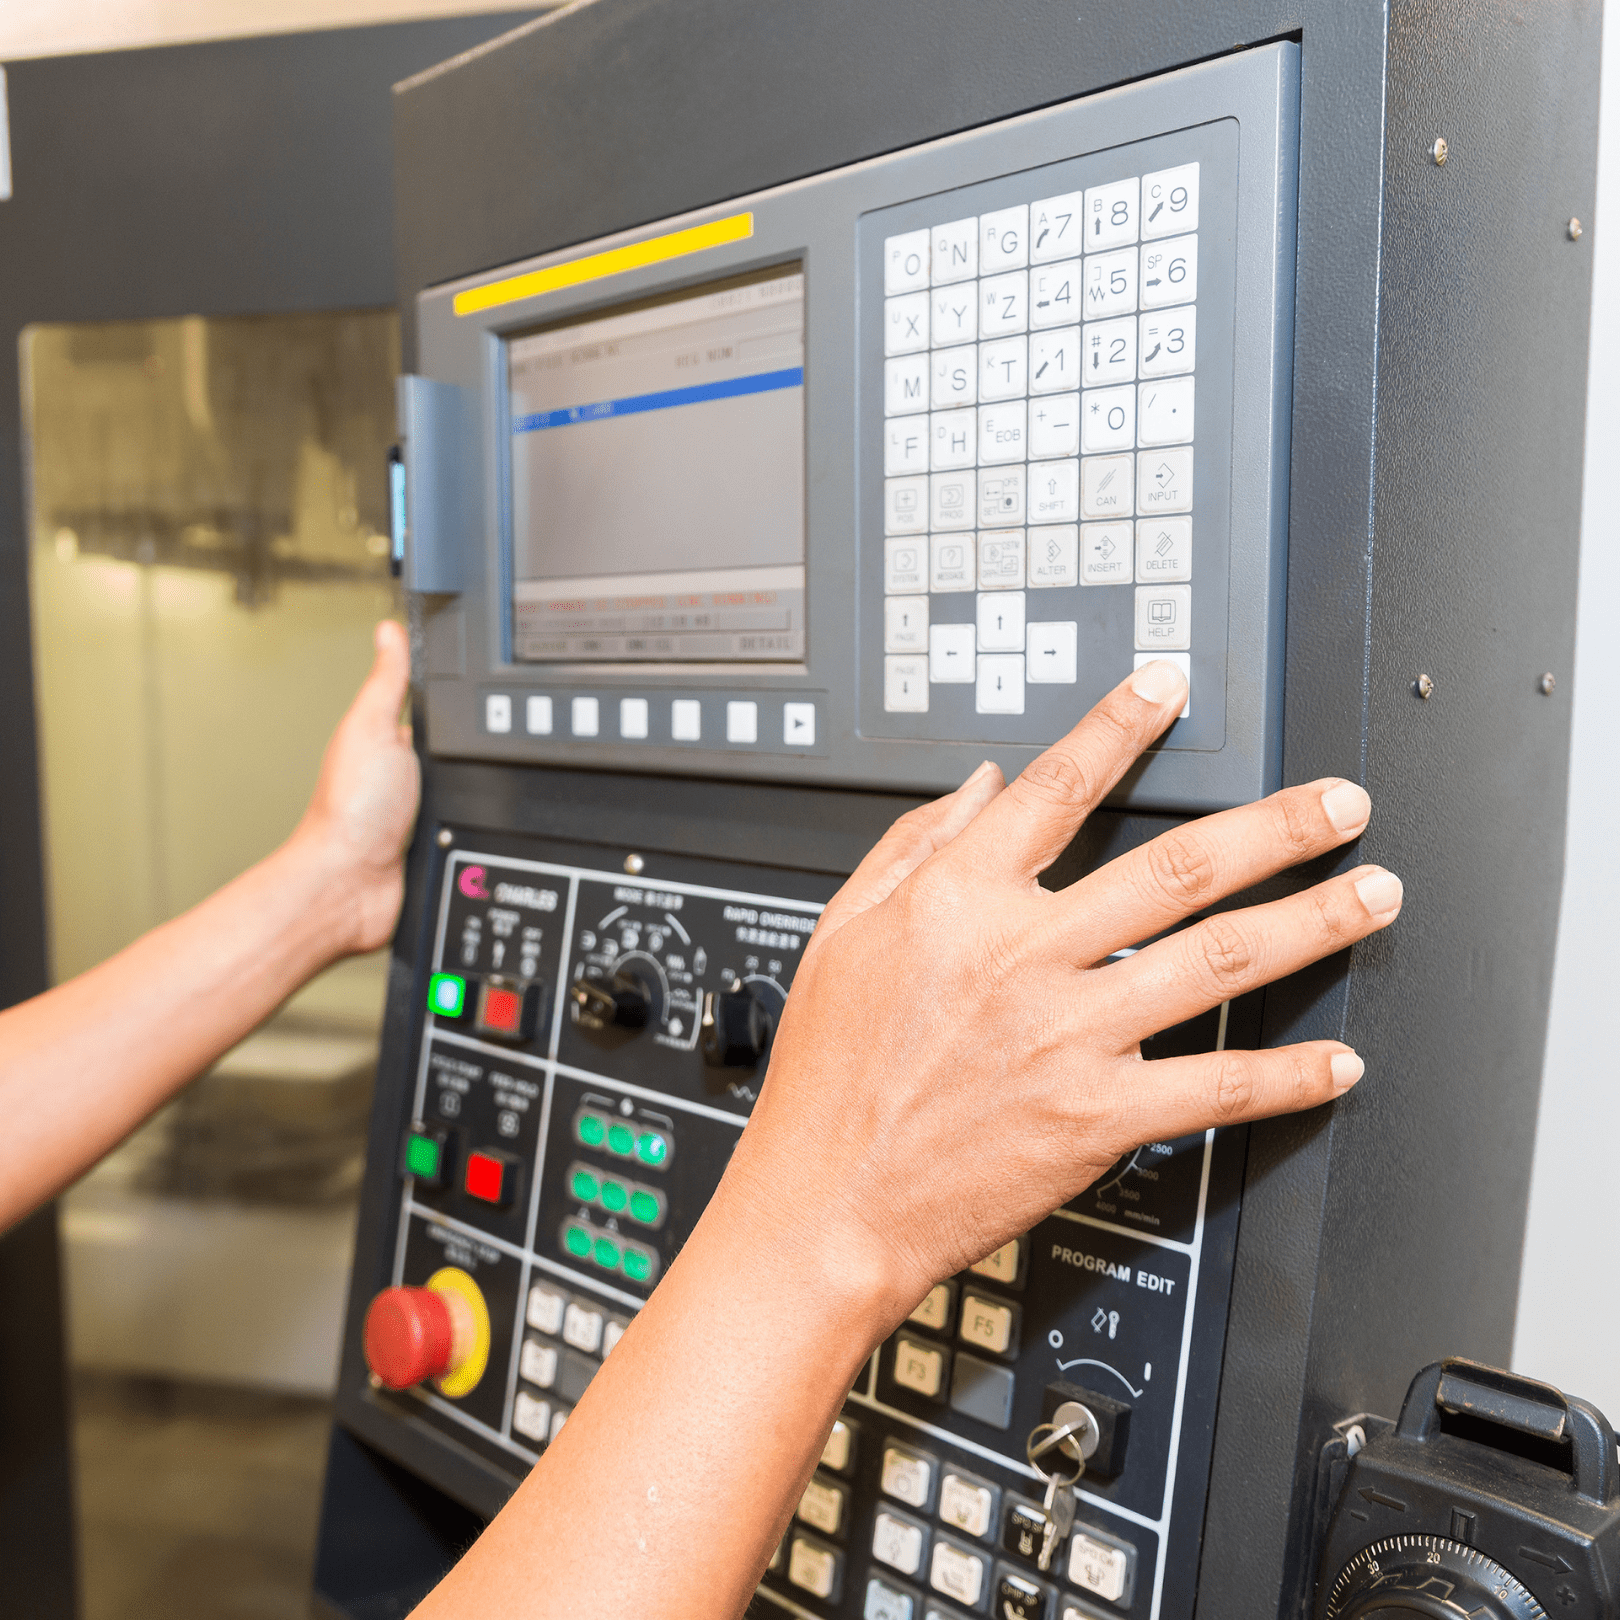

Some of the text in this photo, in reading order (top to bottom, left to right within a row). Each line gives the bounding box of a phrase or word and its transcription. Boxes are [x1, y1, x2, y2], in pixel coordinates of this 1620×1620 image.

[1151, 184, 1162, 199] C
[1170, 186, 1188, 213] 9
[1093, 199, 1103, 213] B
[1110, 200, 1129, 226] 8
[1038, 212, 1048, 226] A
[1055, 213, 1072, 239] 7
[952, 241, 967, 266] N
[1001, 231, 1018, 254] G
[1147, 254, 1163, 270] SP
[1168, 257, 1186, 284] 6
[1054, 280, 1071, 304] 4
[1110, 268, 1127, 295] 5
[952, 305, 968, 328] Y
[1002, 295, 1016, 320] Z
[905, 314, 920, 339] X
[1109, 338, 1126, 363] 2
[1166, 328, 1185, 354] 3
[1000, 359, 1017, 383] T
[1055, 348, 1064, 371] 1
[904, 376, 920, 399] M
[951, 368, 967, 391] S
[951, 431, 966, 453] H
[996, 428, 1021, 443] EOB
[905, 436, 919, 459] F
[1038, 500, 1065, 511] SHIFT
[1096, 496, 1117, 507] CAN
[1148, 490, 1178, 502] INPUT
[1037, 565, 1066, 576] ALTER
[1087, 562, 1122, 573] INSERT
[1146, 559, 1178, 570] DELETE
[1148, 627, 1175, 637] HELP
[1150, 1142, 1173, 1156] 2500
[1124, 1208, 1160, 1226] mm/min
[1052, 1244, 1176, 1296] PROGRAM EDIT
[973, 1315, 995, 1338] F5
[906, 1359, 927, 1382] F3
[1366, 1560, 1380, 1575] 30
[1426, 1551, 1441, 1565] 20
[1493, 1583, 1508, 1600] 10
